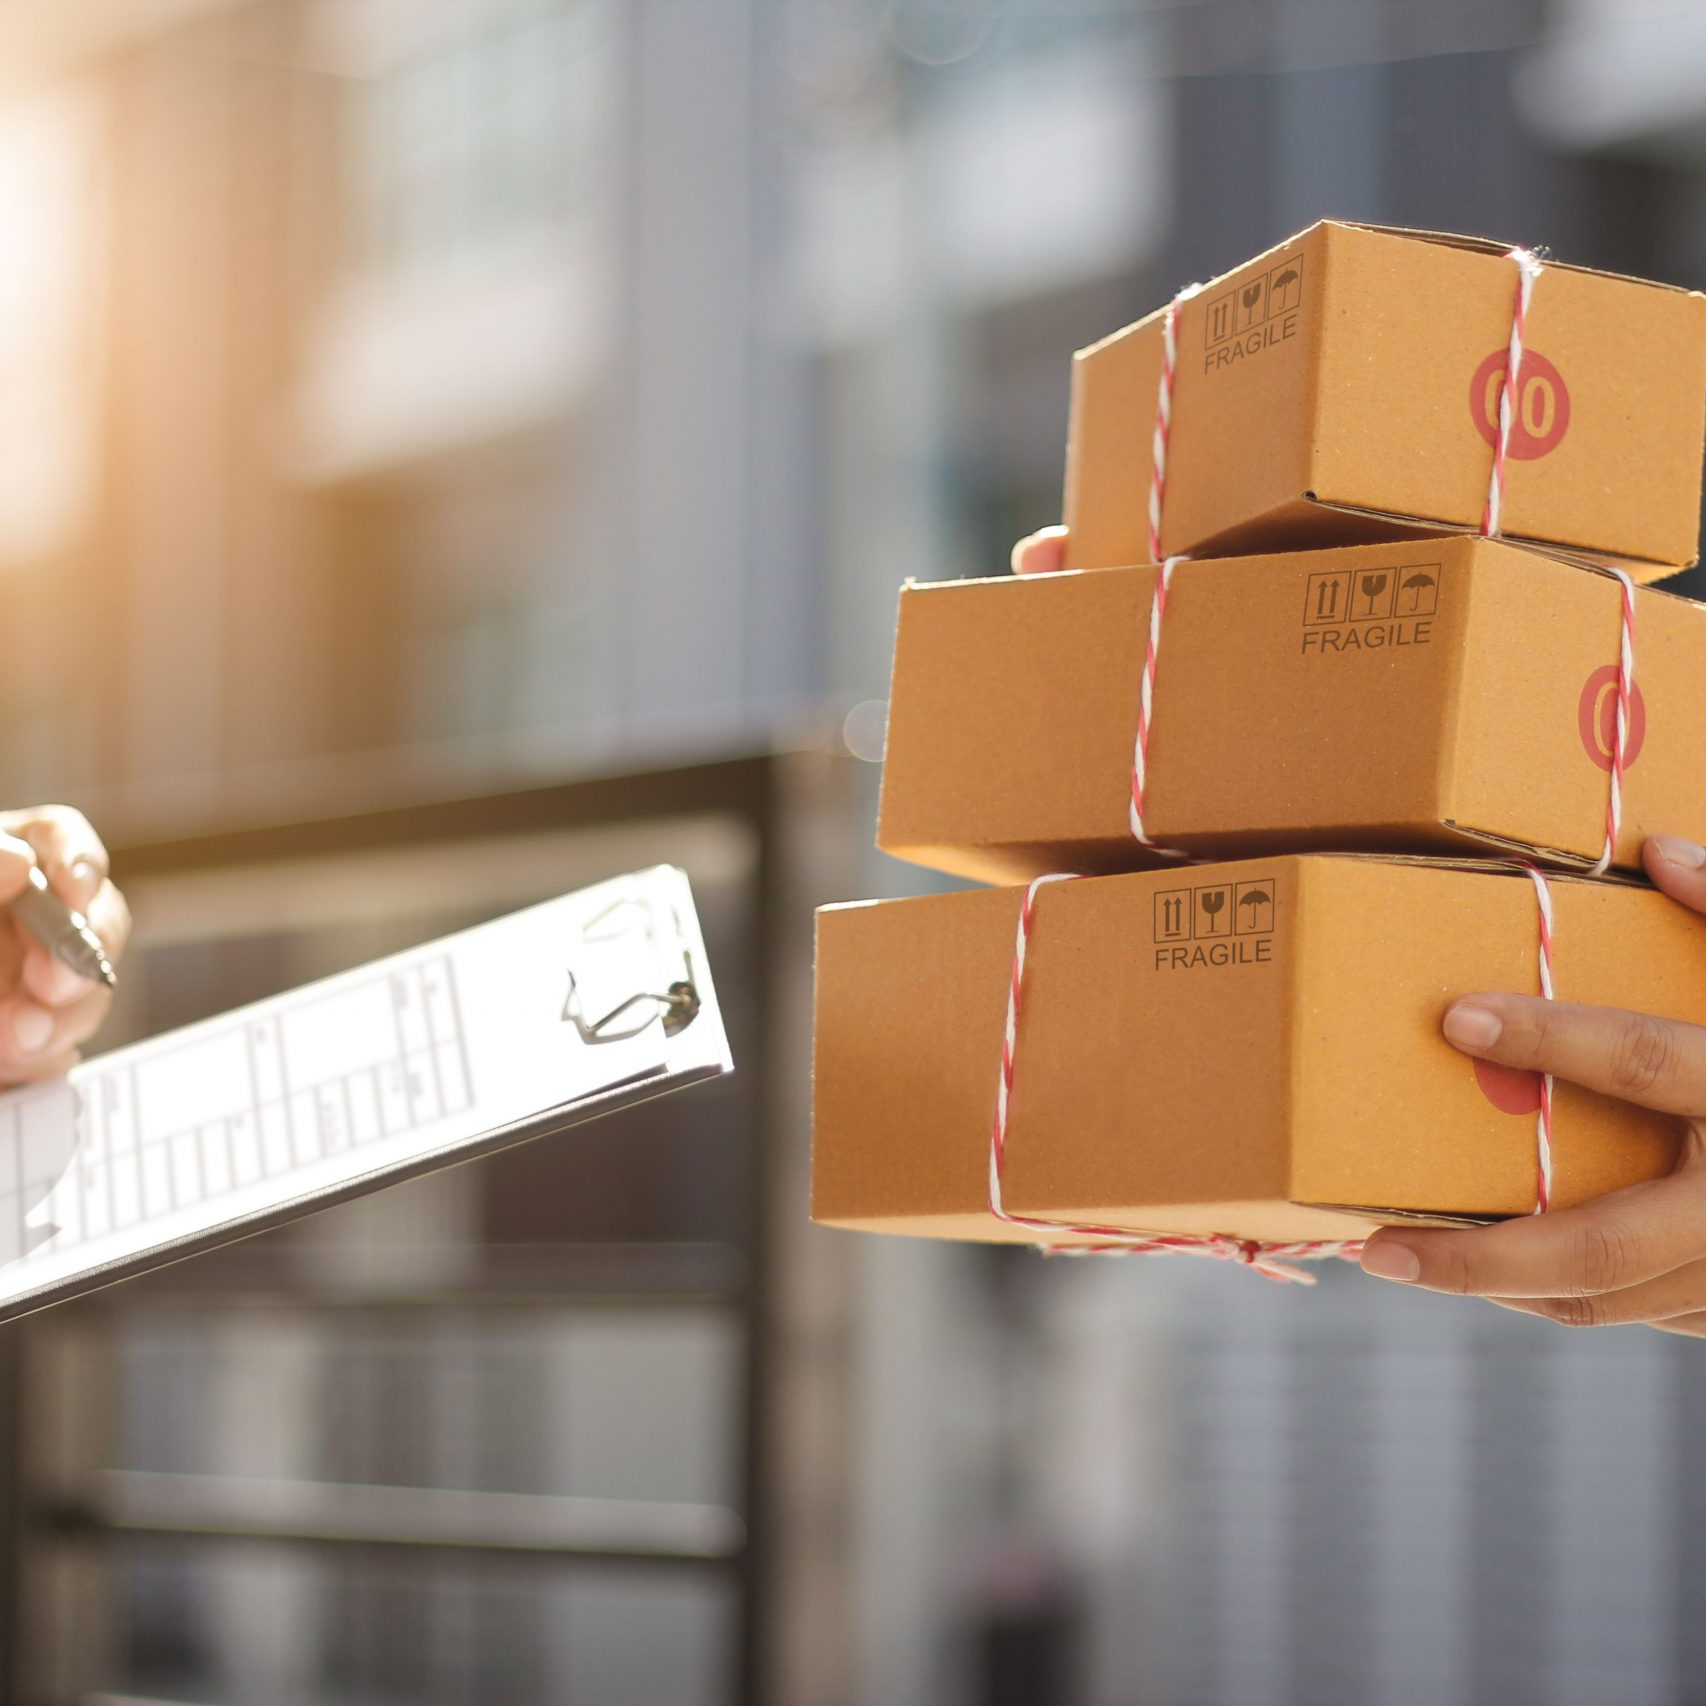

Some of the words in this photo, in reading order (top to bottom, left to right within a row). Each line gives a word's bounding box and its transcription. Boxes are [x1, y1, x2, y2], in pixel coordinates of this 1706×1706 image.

[1204, 314, 1298, 375] FRAGILE
[1301, 621, 1433, 655] FRAGILE
[1155, 938, 1272, 971] FRAGILE
